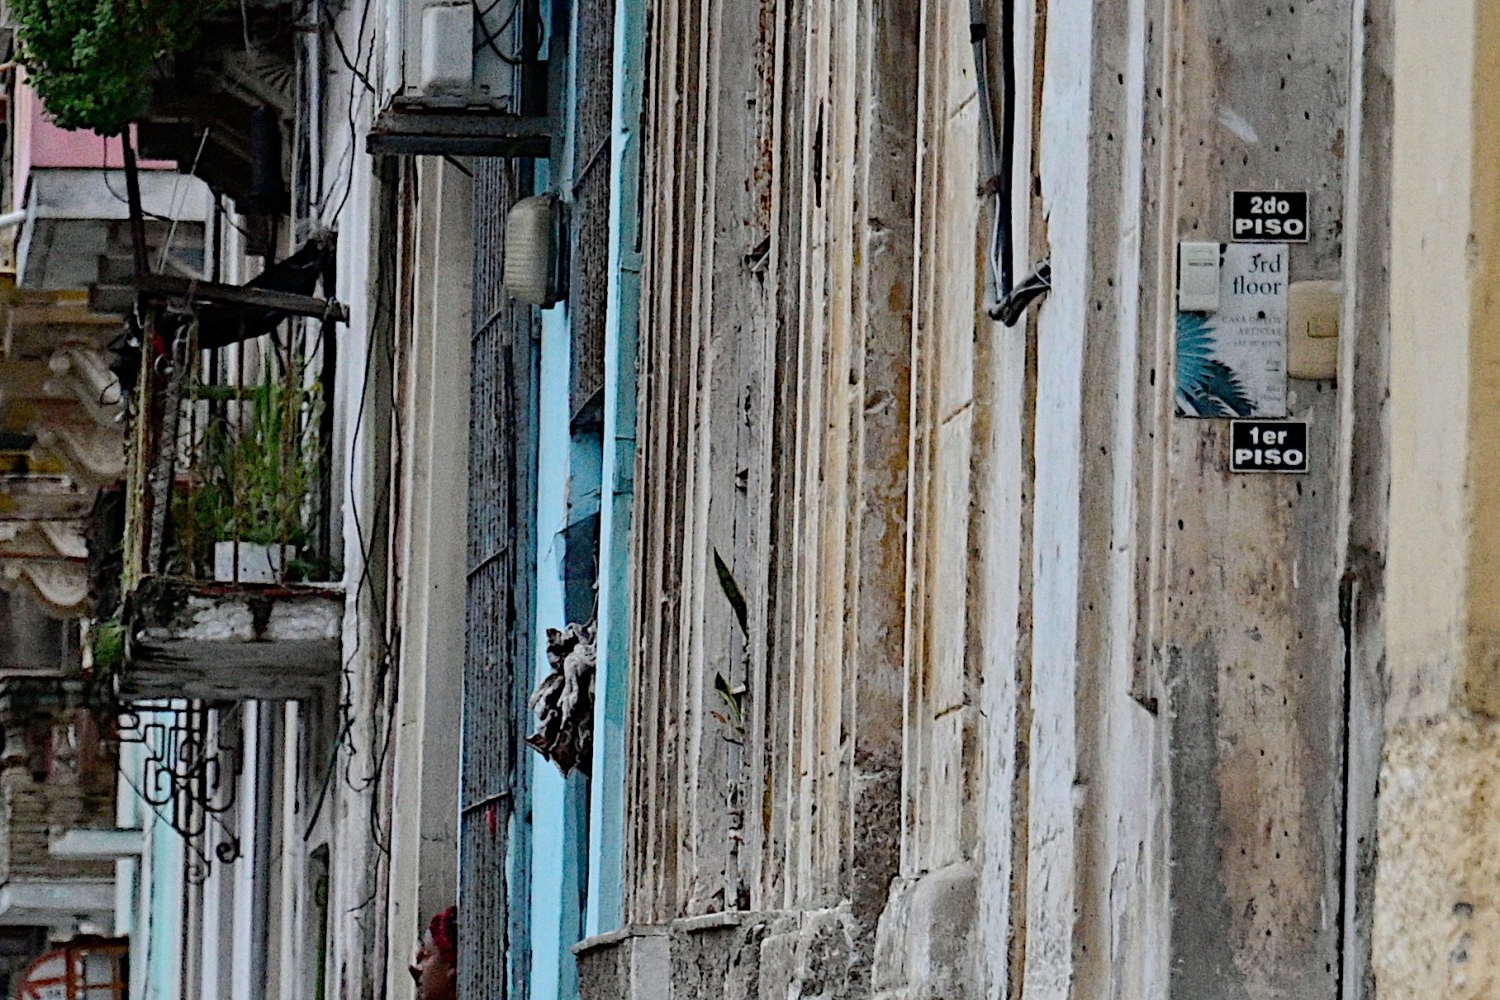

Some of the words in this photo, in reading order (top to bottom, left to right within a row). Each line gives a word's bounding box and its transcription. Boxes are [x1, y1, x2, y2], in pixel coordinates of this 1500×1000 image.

[1250, 195, 1290, 215] 2do
[1235, 218, 1304, 236] PISO
[1248, 253, 1281, 273] 3rd
[1233, 275, 1281, 295] floor
[1249, 426, 1288, 446] 1er
[1235, 448, 1304, 466] PISO
